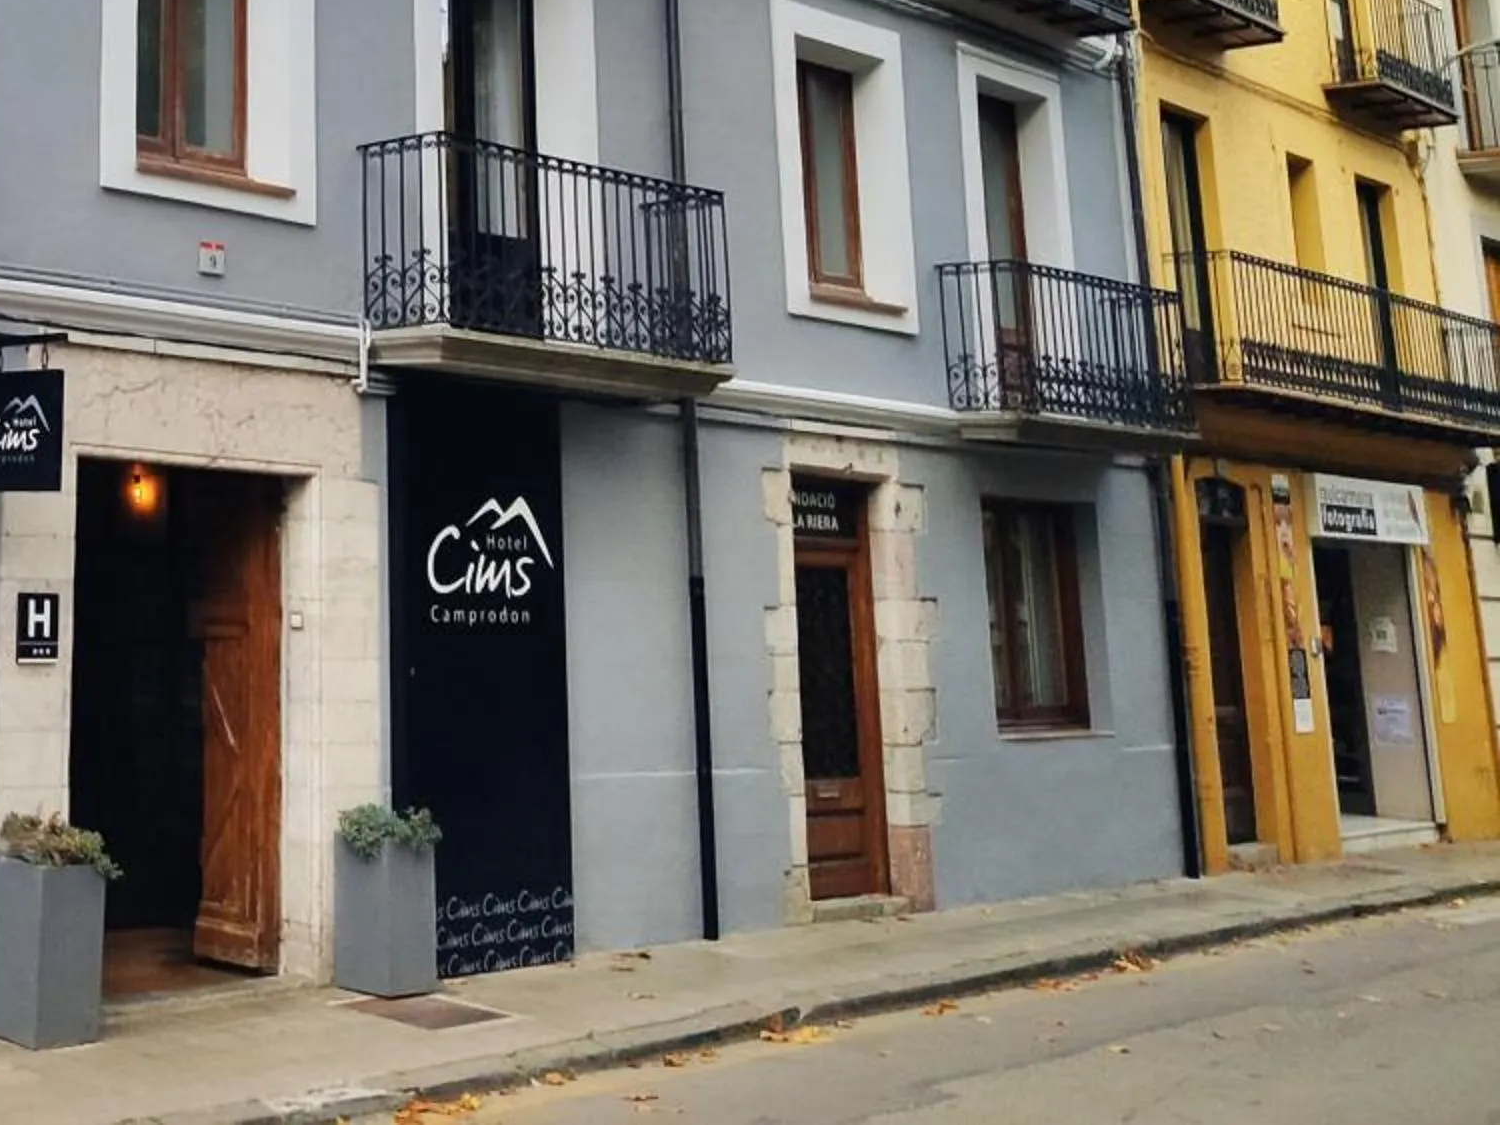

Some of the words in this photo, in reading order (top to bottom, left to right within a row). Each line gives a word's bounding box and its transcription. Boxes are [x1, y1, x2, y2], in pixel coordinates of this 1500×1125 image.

[806, 514, 840, 532] RIERA
[486, 534, 528, 551] Hotel
[427, 524, 535, 599] Cims
[28, 598, 51, 638] H
[430, 604, 532, 627] Camprodon
